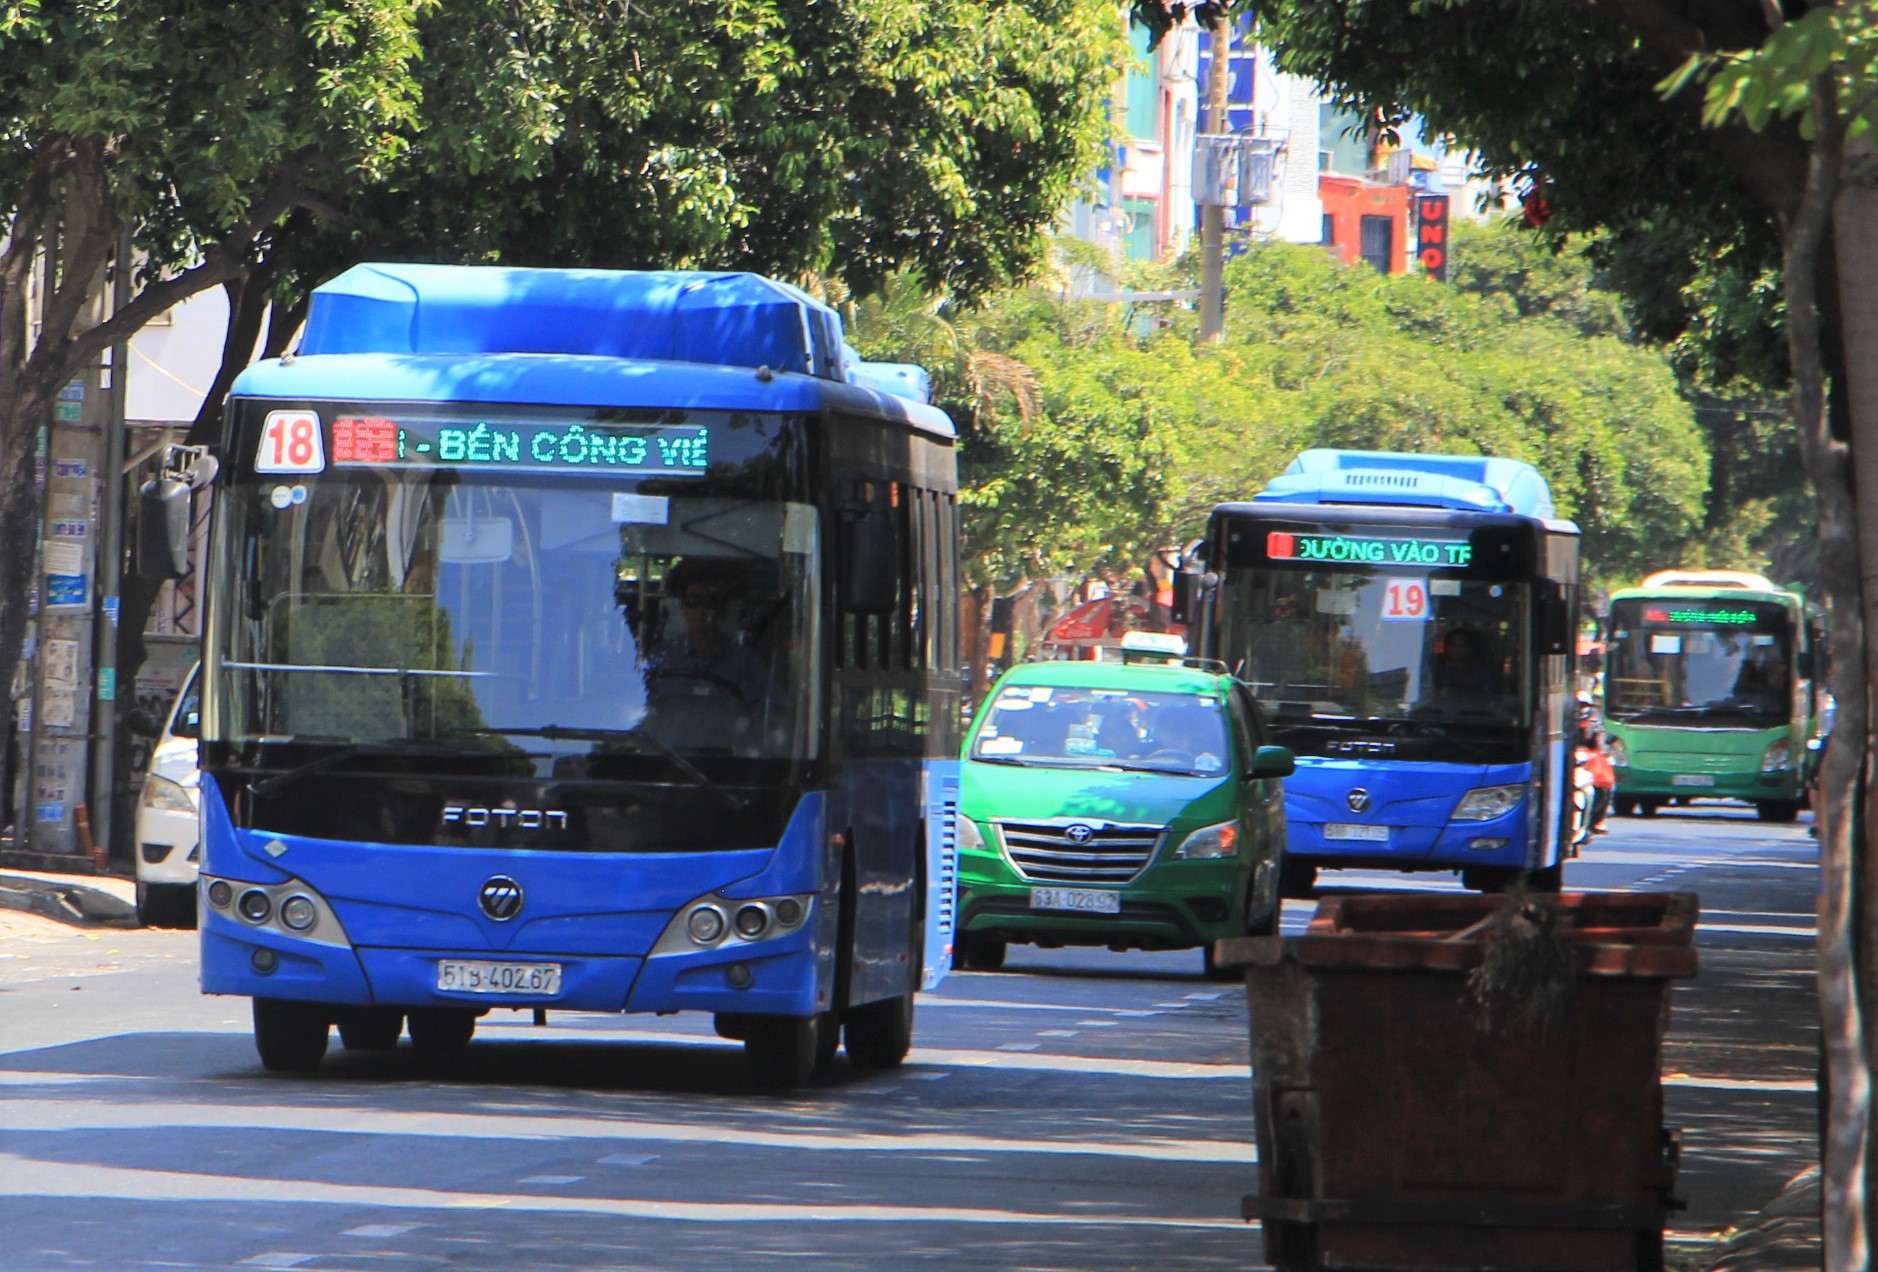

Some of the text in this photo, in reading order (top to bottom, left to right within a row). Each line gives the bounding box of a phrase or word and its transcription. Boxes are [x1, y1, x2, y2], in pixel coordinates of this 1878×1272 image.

[269, 418, 313, 465] 18
[531, 424, 647, 464] CÔNG
[1391, 538, 1440, 563] VÀO
[1388, 585, 1424, 616] 19
